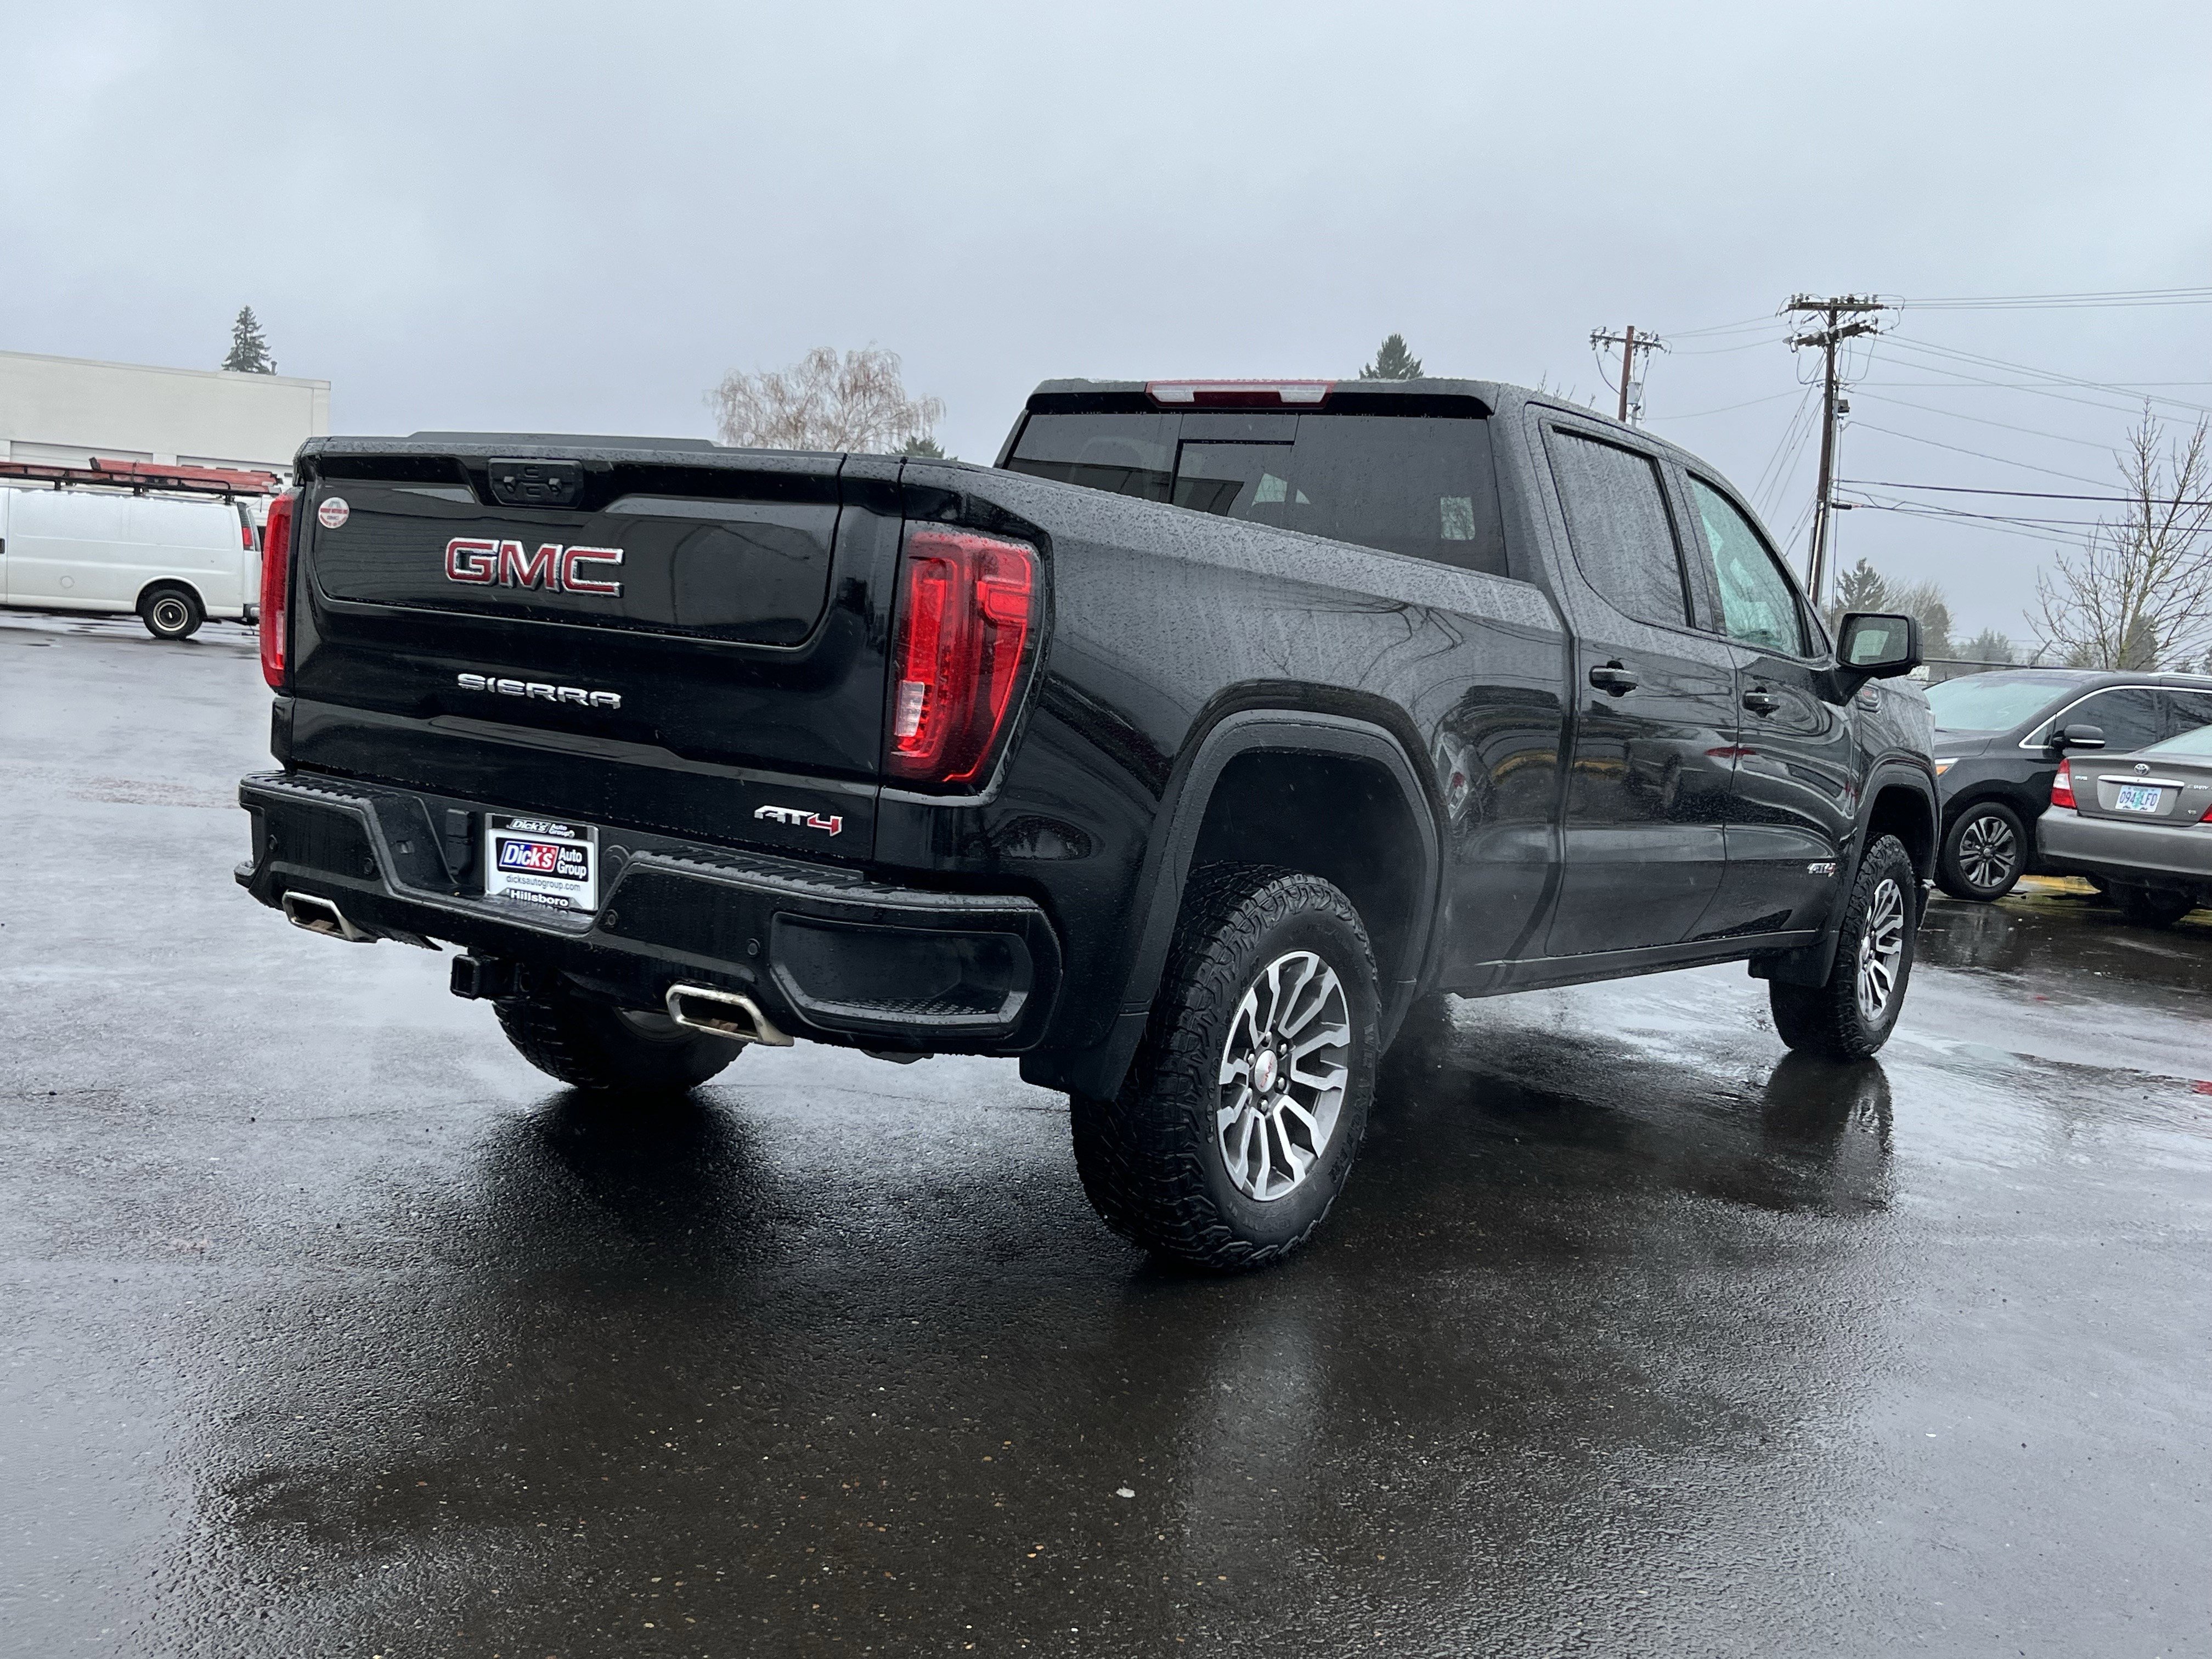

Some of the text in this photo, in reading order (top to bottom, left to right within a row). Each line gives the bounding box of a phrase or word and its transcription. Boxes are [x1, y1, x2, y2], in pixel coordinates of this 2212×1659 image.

[445, 537, 624, 598] GMC
[458, 673, 621, 709] SIERRA
[2119, 791, 2137, 804] 094
[754, 805, 843, 837] AT4
[558, 847, 583, 863] Auto
[557, 860, 587, 879] Group
[506, 874, 581, 891] dicksautogroup.com
[510, 889, 569, 907] Hillsboro
